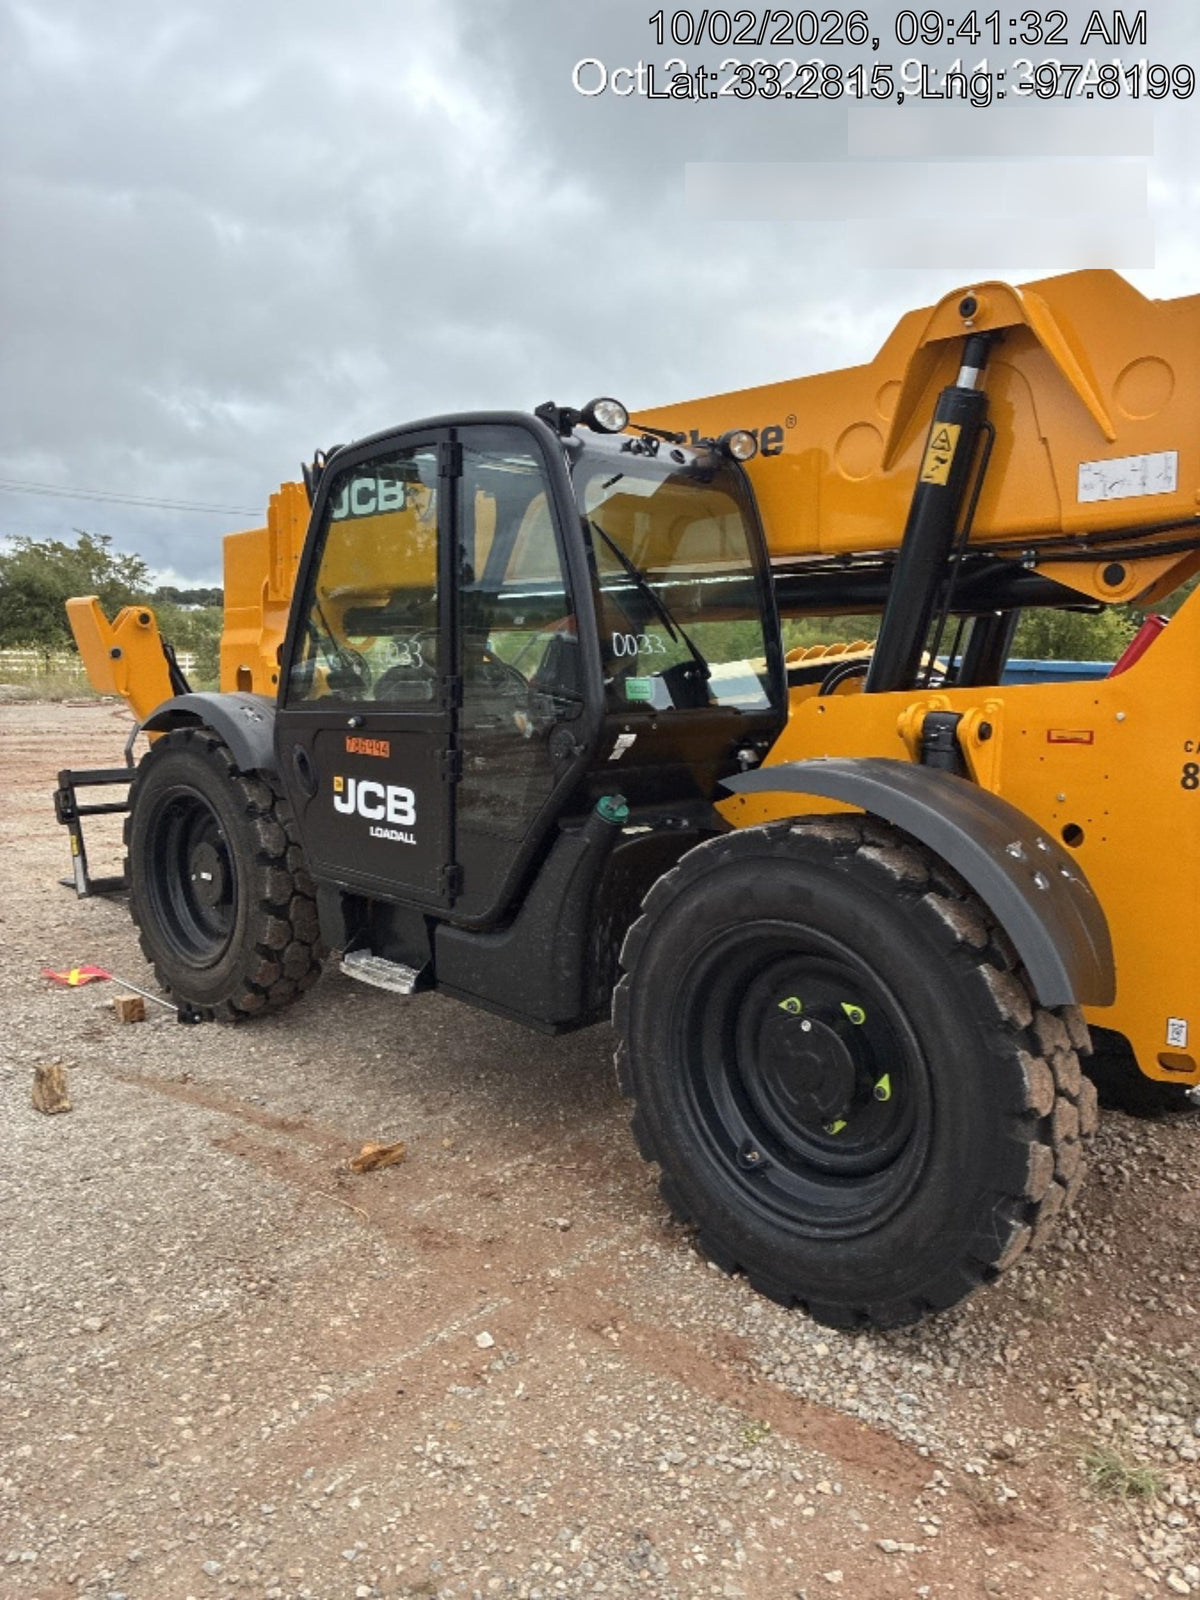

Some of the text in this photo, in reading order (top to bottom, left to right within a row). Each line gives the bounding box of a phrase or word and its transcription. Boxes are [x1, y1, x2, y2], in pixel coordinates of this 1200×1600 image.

[332, 478, 404, 518] JCB
[612, 632, 667, 657] 0033
[333, 778, 416, 826] JCB
[369, 826, 417, 845] LOADALL
